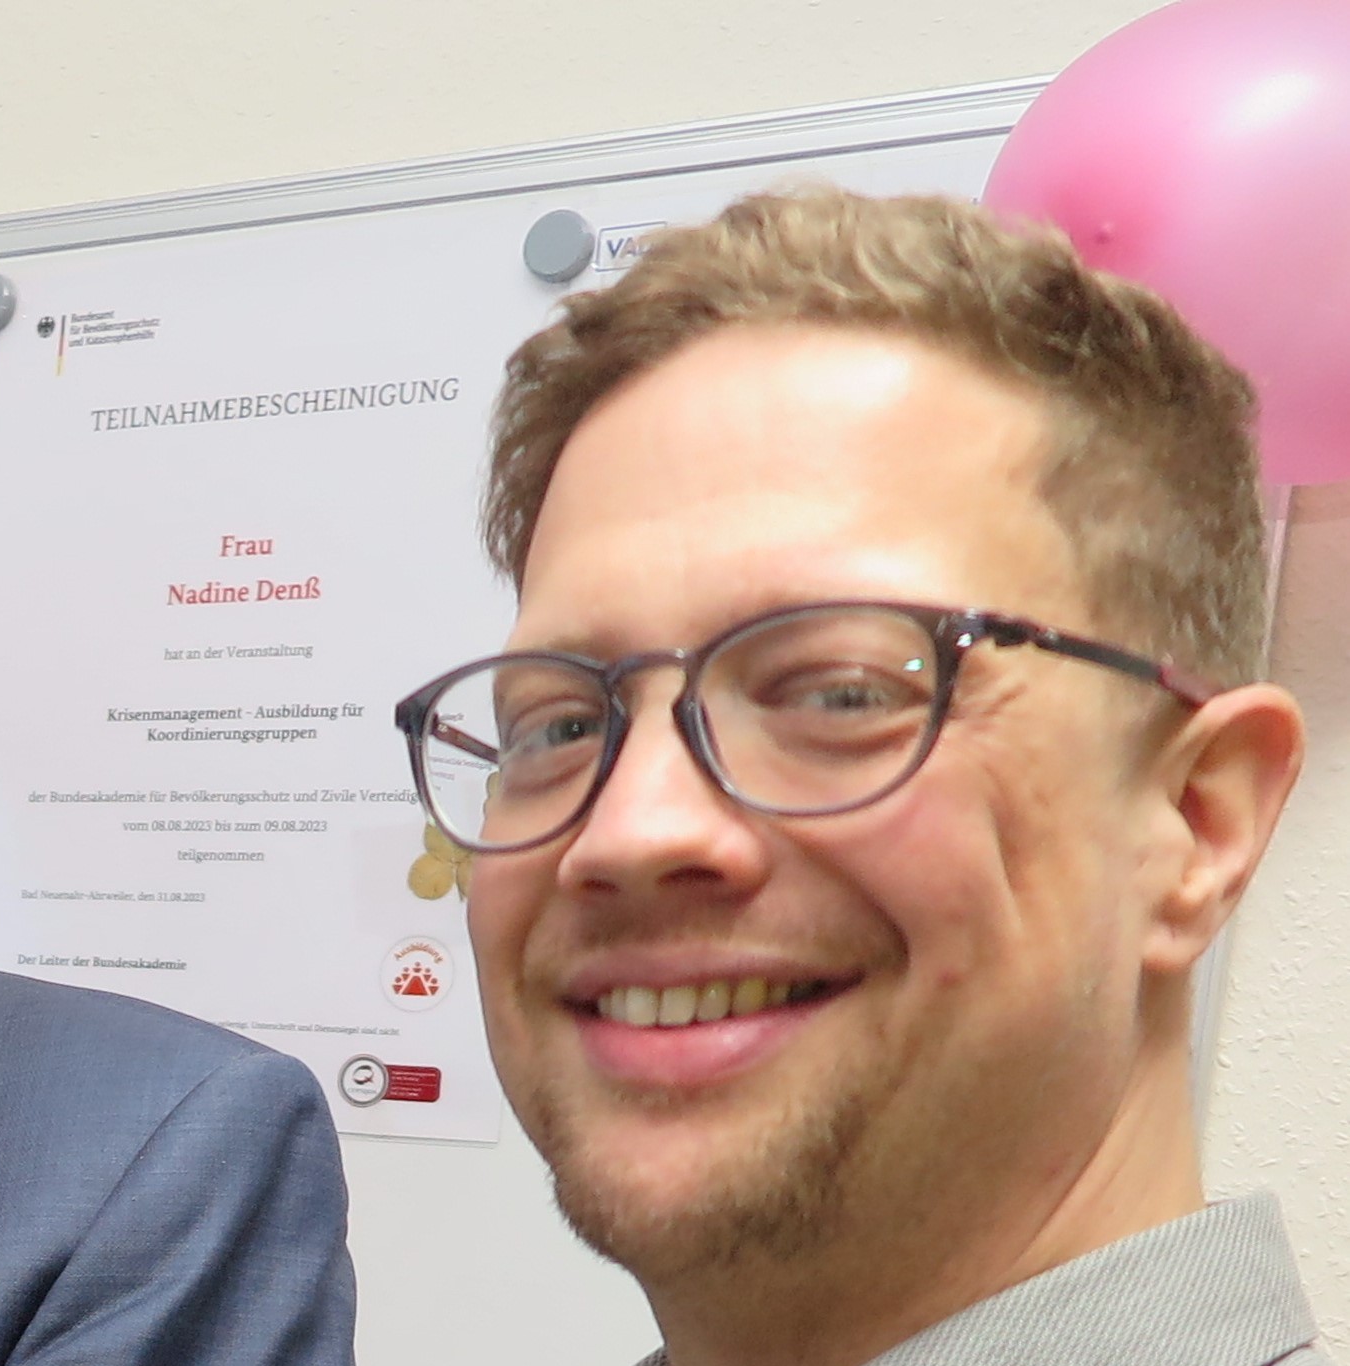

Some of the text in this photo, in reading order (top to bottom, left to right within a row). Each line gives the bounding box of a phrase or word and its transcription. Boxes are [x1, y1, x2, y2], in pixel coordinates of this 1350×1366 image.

[91, 377, 460, 432] TEILNAHMEBESCHEINIGUNG
[219, 535, 273, 557] Frau
[166, 576, 322, 606] Nadine Denß
[164, 644, 314, 660] hat an der Veranstaltung
[107, 708, 242, 723] Krisenmanagement
[254, 704, 338, 720] Ausbildung
[341, 703, 365, 718] für
[147, 727, 317, 743] Koordinierungsgruppen
[28, 789, 422, 805] der Bundesakademie für Bevölkerungsschutz und Zivile Verteidig
[123, 820, 328, 832] vom 08.08.2023 bis zum 09.08.2023
[177, 849, 264, 863] teilgenommen
[138, 891, 155, 901] den
[393, 942, 444, 965] Ausbildung
[17, 954, 187, 970] Der Leiter der Bundesakademie
